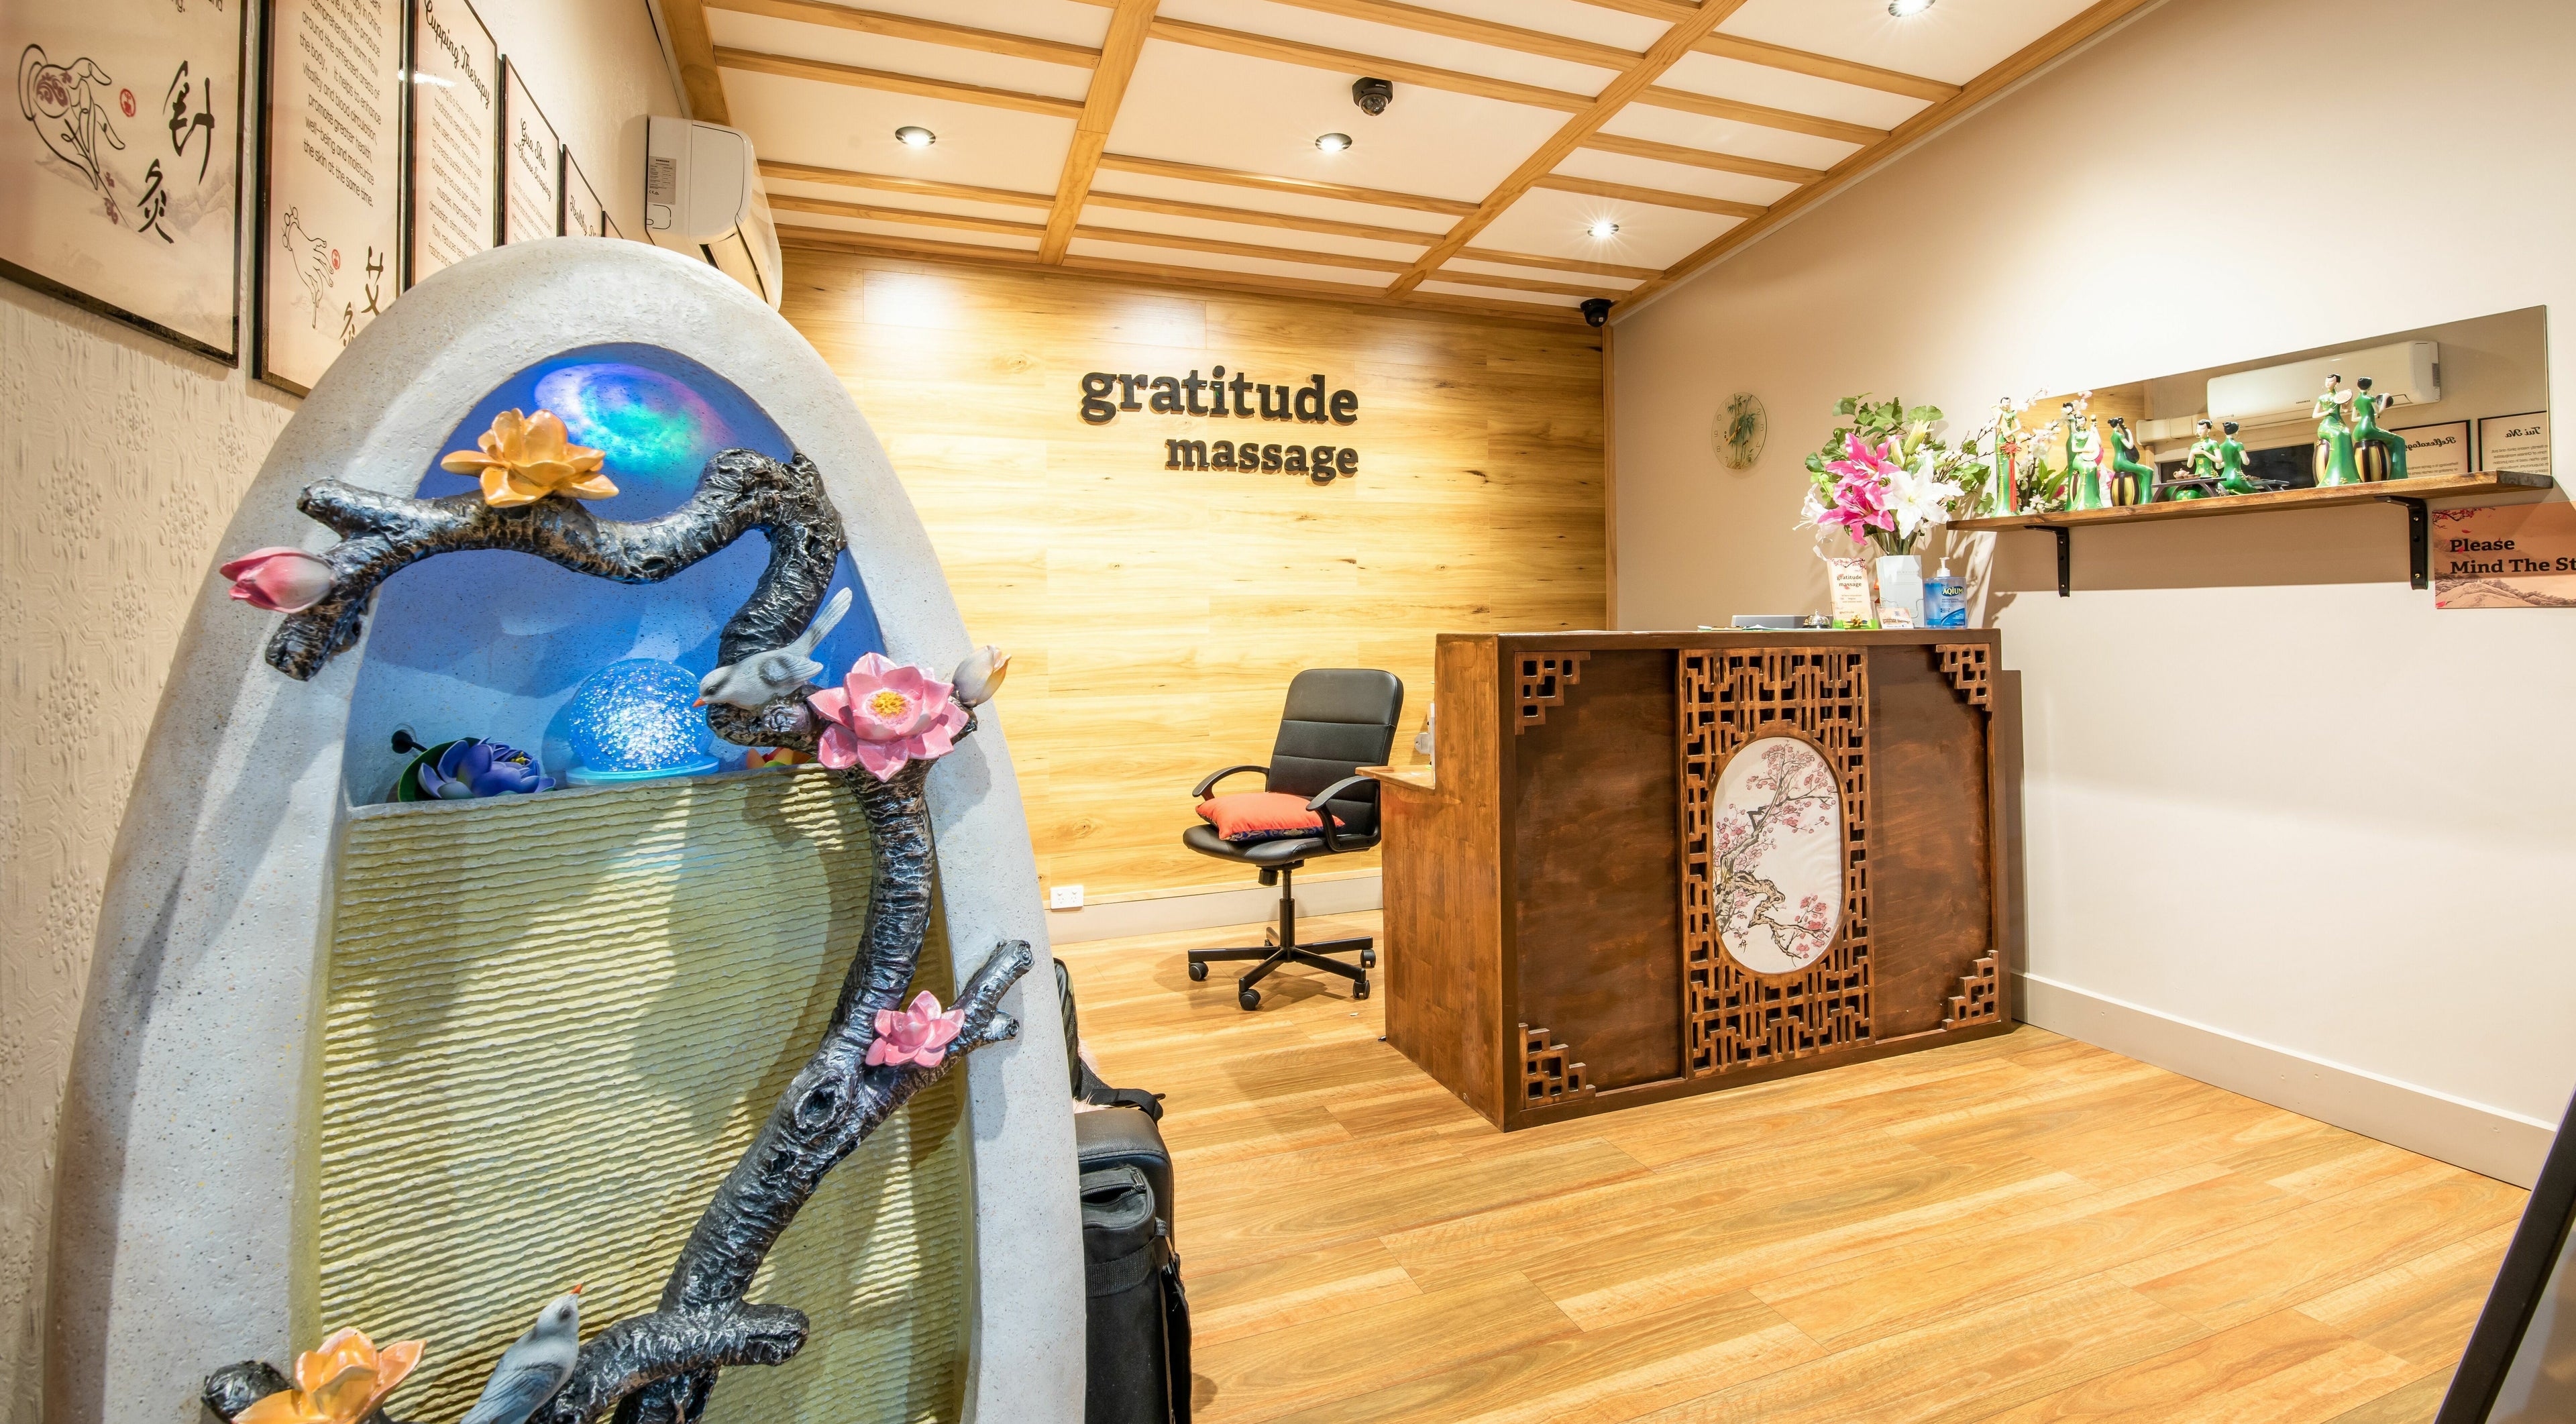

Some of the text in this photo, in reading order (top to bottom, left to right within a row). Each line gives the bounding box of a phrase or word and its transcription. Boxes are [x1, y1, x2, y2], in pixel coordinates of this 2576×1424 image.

[302, 11, 323, 42] around
[325, 32, 334, 53] the
[335, 47, 359, 78] affected
[360, 28, 380, 58] produce
[424, 0, 490, 110] Cupping Therapy
[299, 31, 310, 53] the
[339, 72, 353, 97] helps
[354, 87, 360, 103] to
[360, 97, 381, 125] enhance
[303, 61, 323, 93] vitality
[324, 84, 334, 103] and
[335, 91, 350, 117] blood
[309, 93, 333, 125] promote
[334, 119, 354, 145] greater
[303, 138, 315, 158] the
[315, 149, 327, 169] skin
[327, 161, 335, 176] at
[335, 165, 345, 184] the
[345, 176, 360, 197] same
[336, 144, 347, 162] and
[521, 117, 547, 171] Gua Sha
[533, 166, 552, 203] Scraping
[570, 195, 588, 237] Healthy
[1079, 365, 1359, 426] gratitude
[1165, 438, 1359, 484] massage
[2450, 537, 2516, 552] Please
[2450, 559, 2504, 574] Mind
[2508, 557, 2551, 573] The
[1942, 586, 1964, 596] AQIUM
